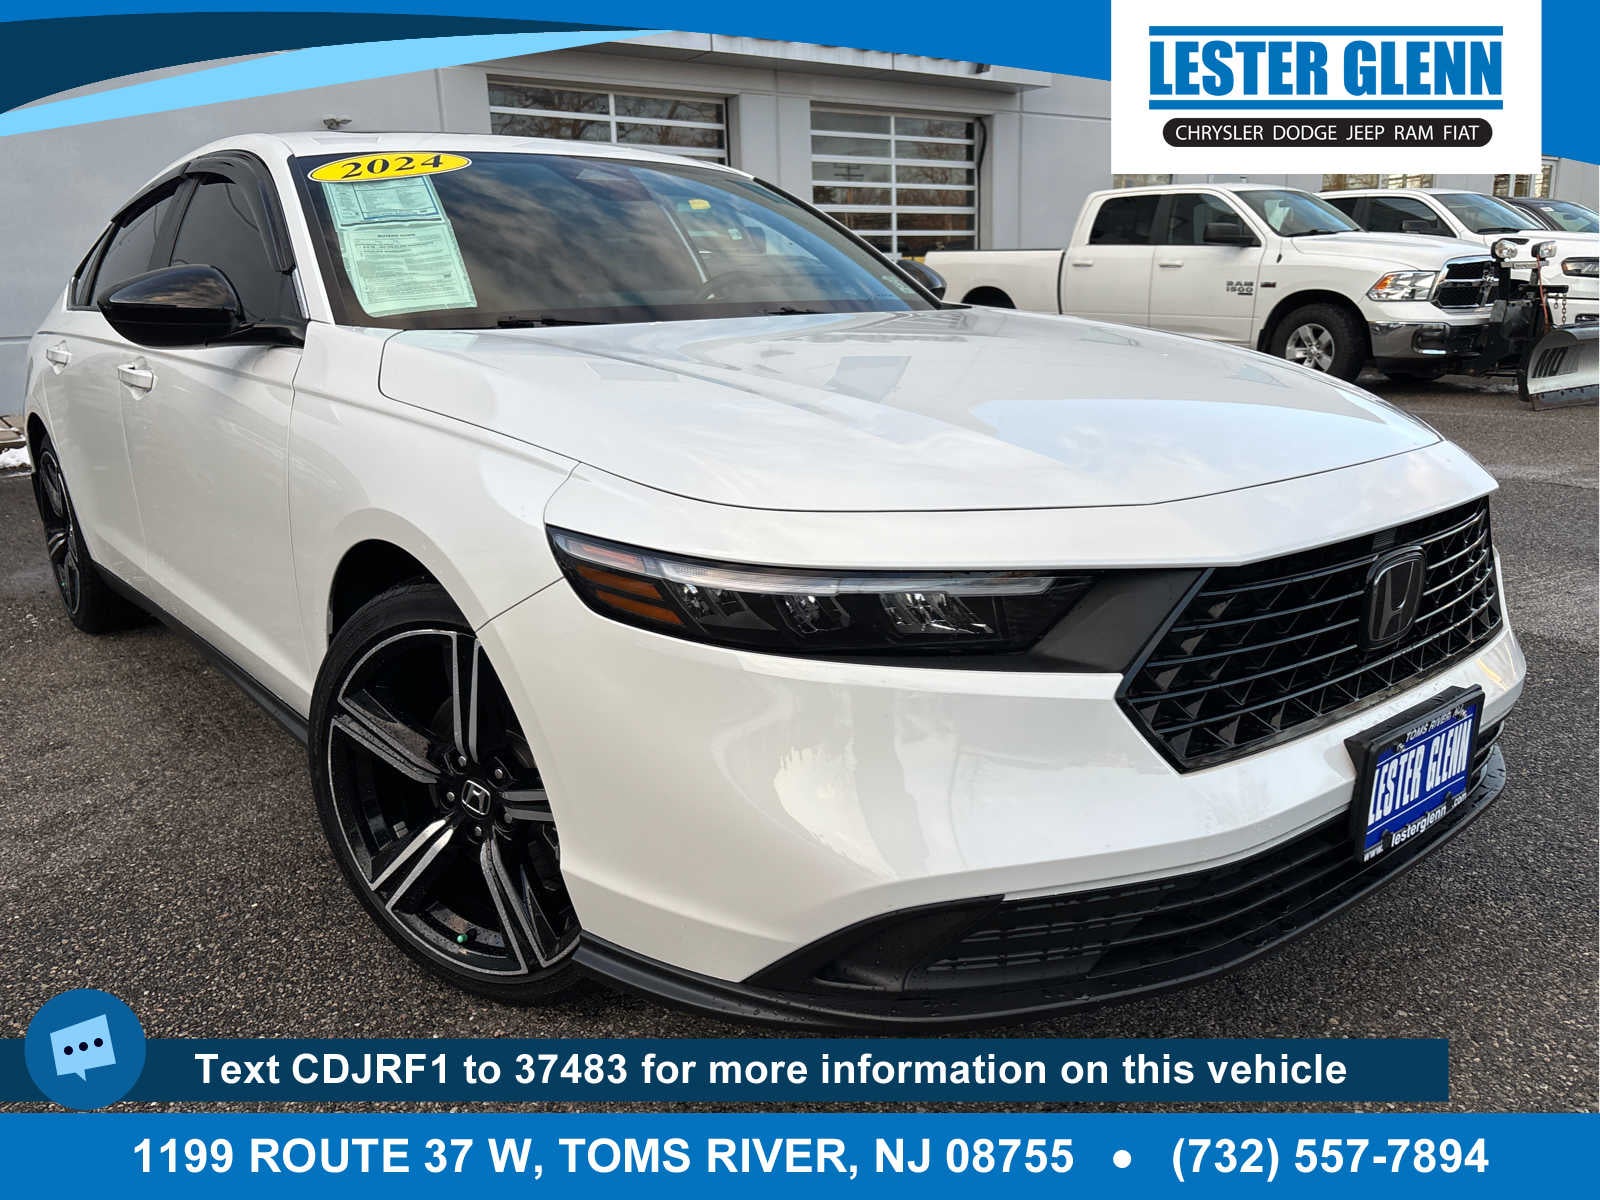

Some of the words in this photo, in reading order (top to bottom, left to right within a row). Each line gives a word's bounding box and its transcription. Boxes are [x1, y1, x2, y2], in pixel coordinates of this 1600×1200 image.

[341, 154, 444, 179] 2024
[1406, 723, 1429, 742] TOMS
[1428, 711, 1452, 731] RIVER
[1367, 744, 1425, 827] LESTER
[1425, 718, 1473, 792] GLENN
